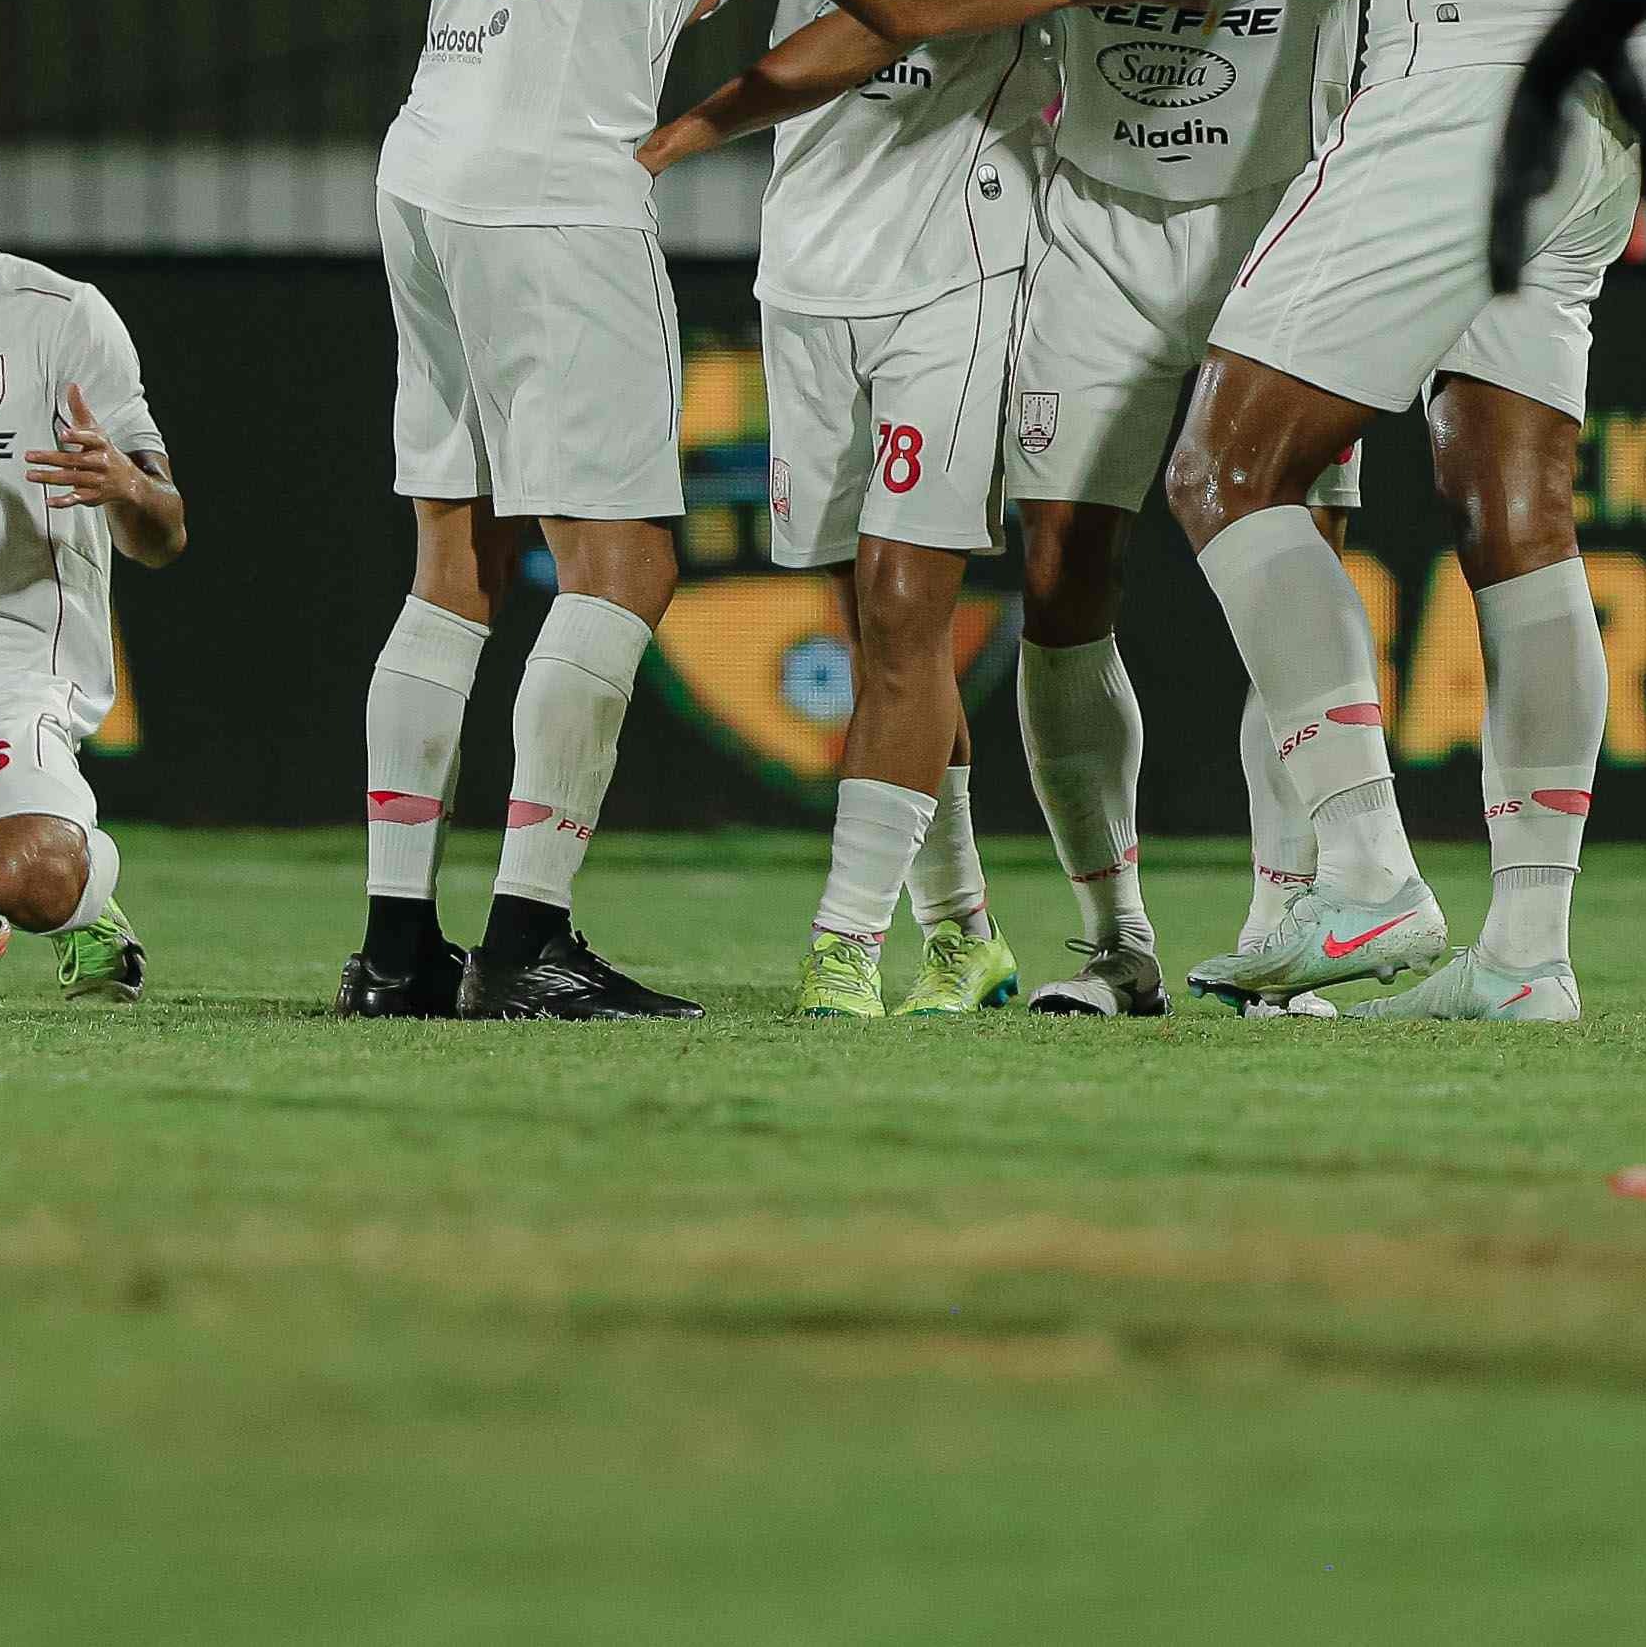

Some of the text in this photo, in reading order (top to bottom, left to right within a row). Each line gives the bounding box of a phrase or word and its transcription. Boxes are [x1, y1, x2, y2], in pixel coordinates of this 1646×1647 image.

[427, 22, 487, 54] dosat
[1119, 54, 1209, 87] Sania
[1113, 118, 1230, 149] Aladin
[1279, 723, 1320, 762] SIS
[1482, 800, 1523, 819] SIS
